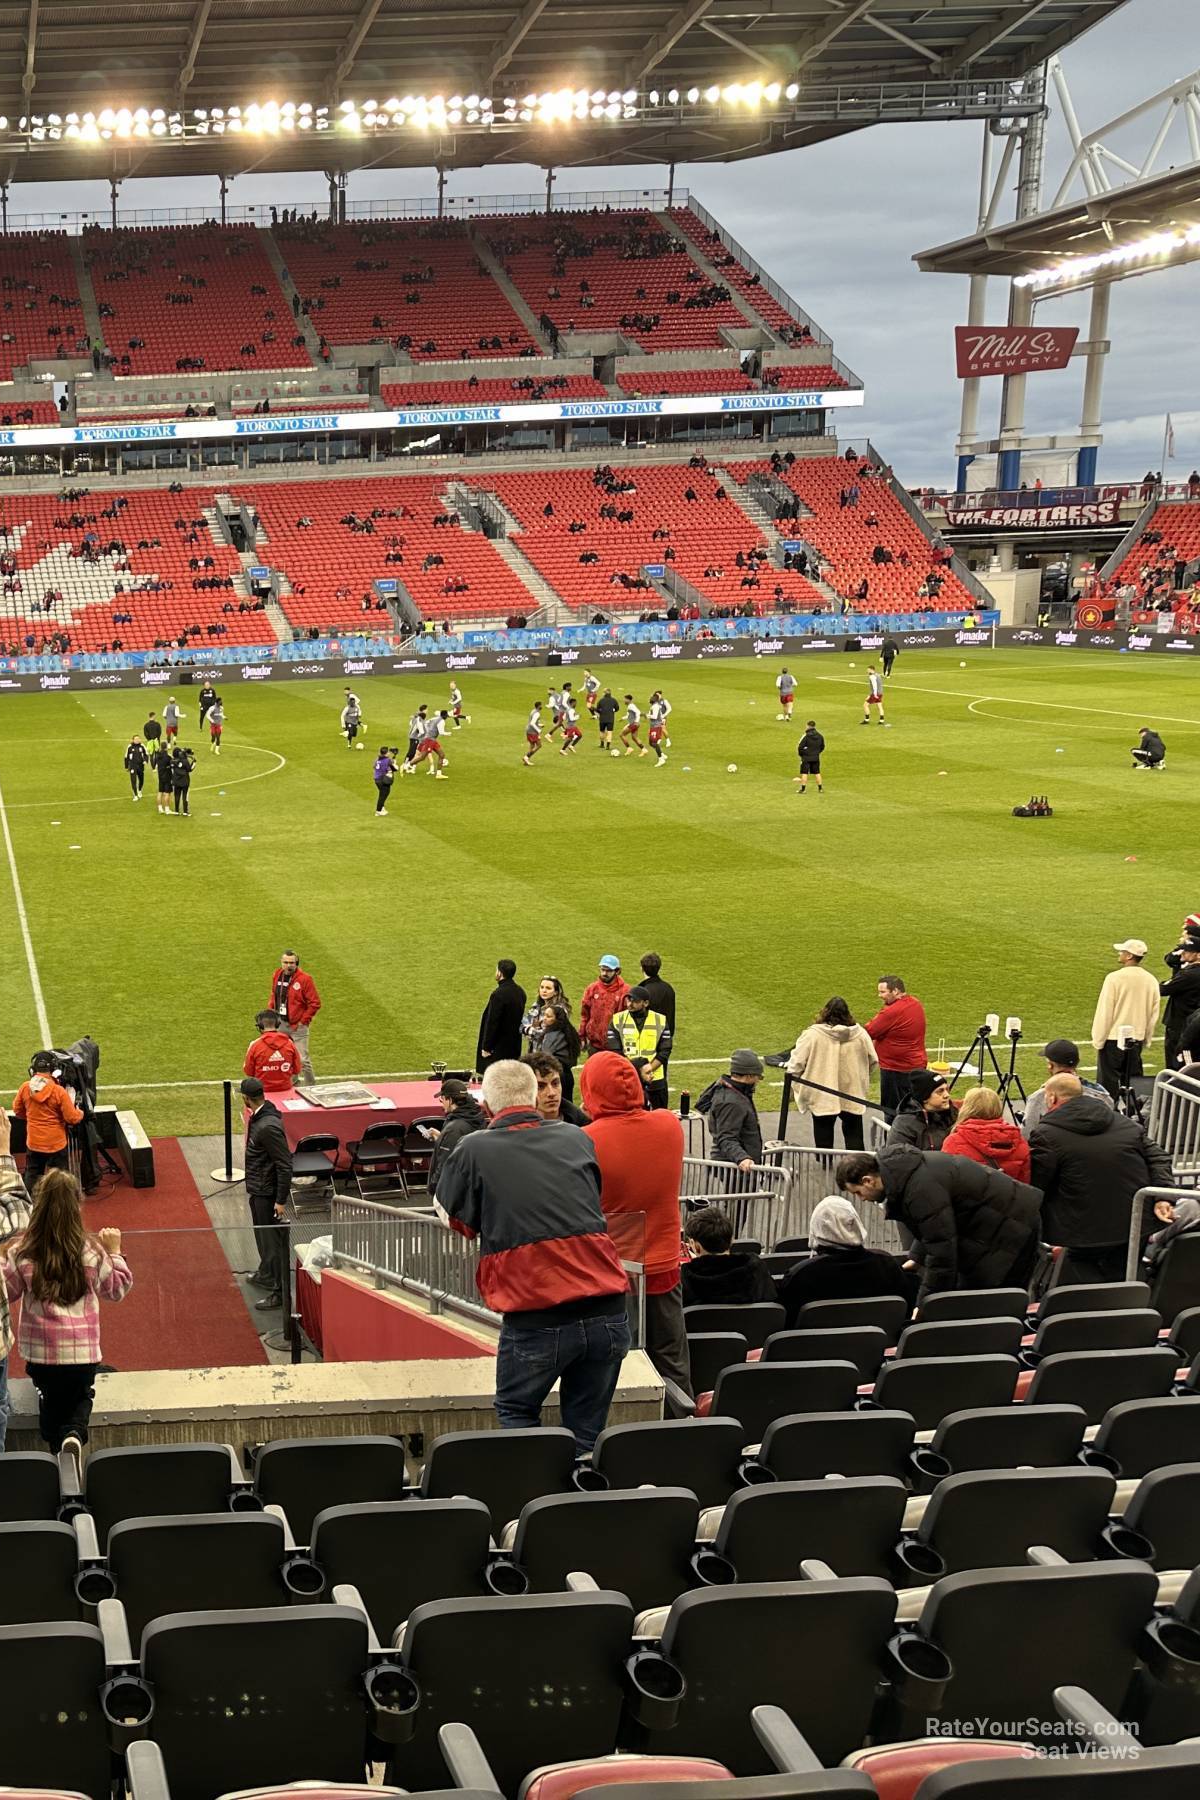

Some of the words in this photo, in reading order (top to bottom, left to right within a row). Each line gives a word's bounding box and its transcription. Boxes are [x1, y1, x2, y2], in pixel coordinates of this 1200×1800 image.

[964, 334, 1027, 361] Mill
[1029, 332, 1061, 357] St.
[970, 356, 1051, 371] BREWERY
[565, 403, 623, 416] TORONTO
[626, 402, 658, 413] STAR
[726, 396, 784, 409] TORONTO
[787, 394, 818, 406] STAR
[403, 410, 461, 424] TORONTO
[464, 409, 496, 420] STAR
[241, 418, 299, 432] TORONTO
[302, 417, 334, 428] STAR
[80, 427, 137, 440] TORONTO
[140, 425, 172, 437] STAR
[990, 502, 1114, 523] FORTRESS
[1003, 519, 1037, 527] PATCH
